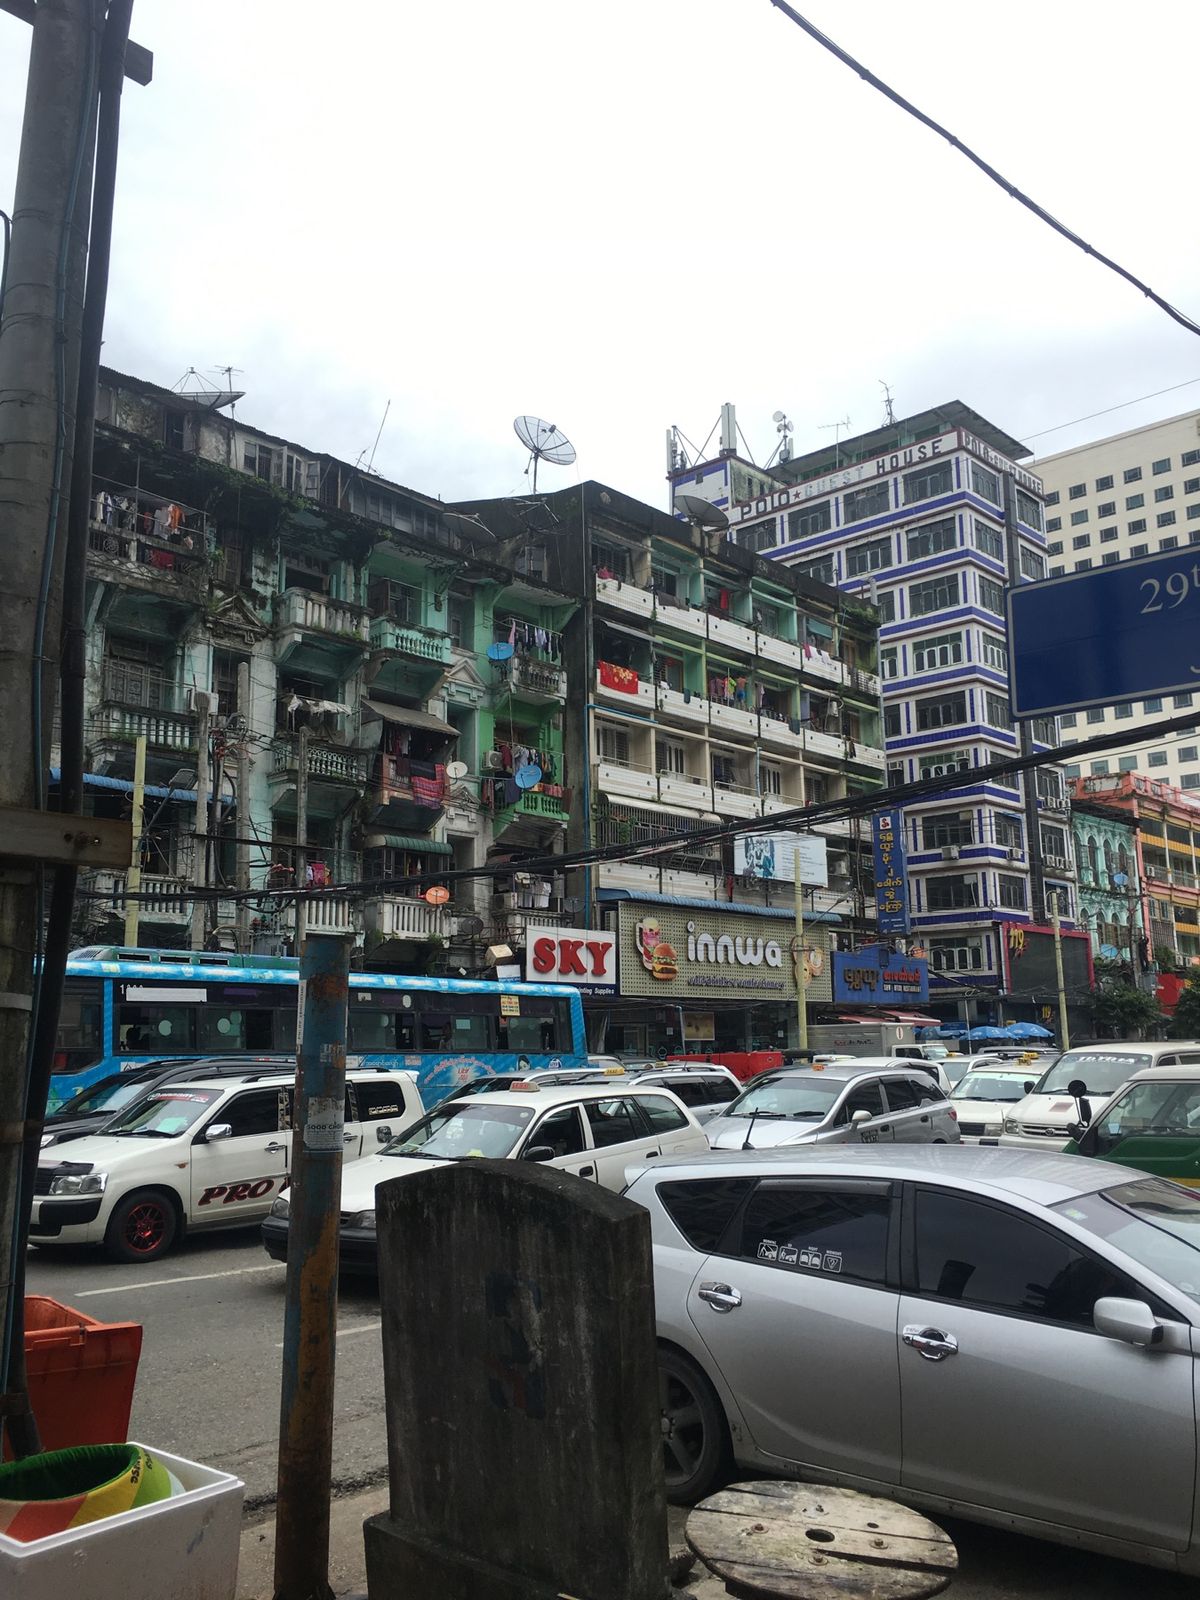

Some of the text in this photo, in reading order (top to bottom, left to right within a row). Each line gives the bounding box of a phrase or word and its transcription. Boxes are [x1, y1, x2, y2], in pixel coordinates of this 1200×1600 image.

[876, 438, 943, 476] HOUSE
[532, 937, 612, 977] SKY
[687, 920, 783, 968] innwa
[197, 1179, 275, 1207] PRO
